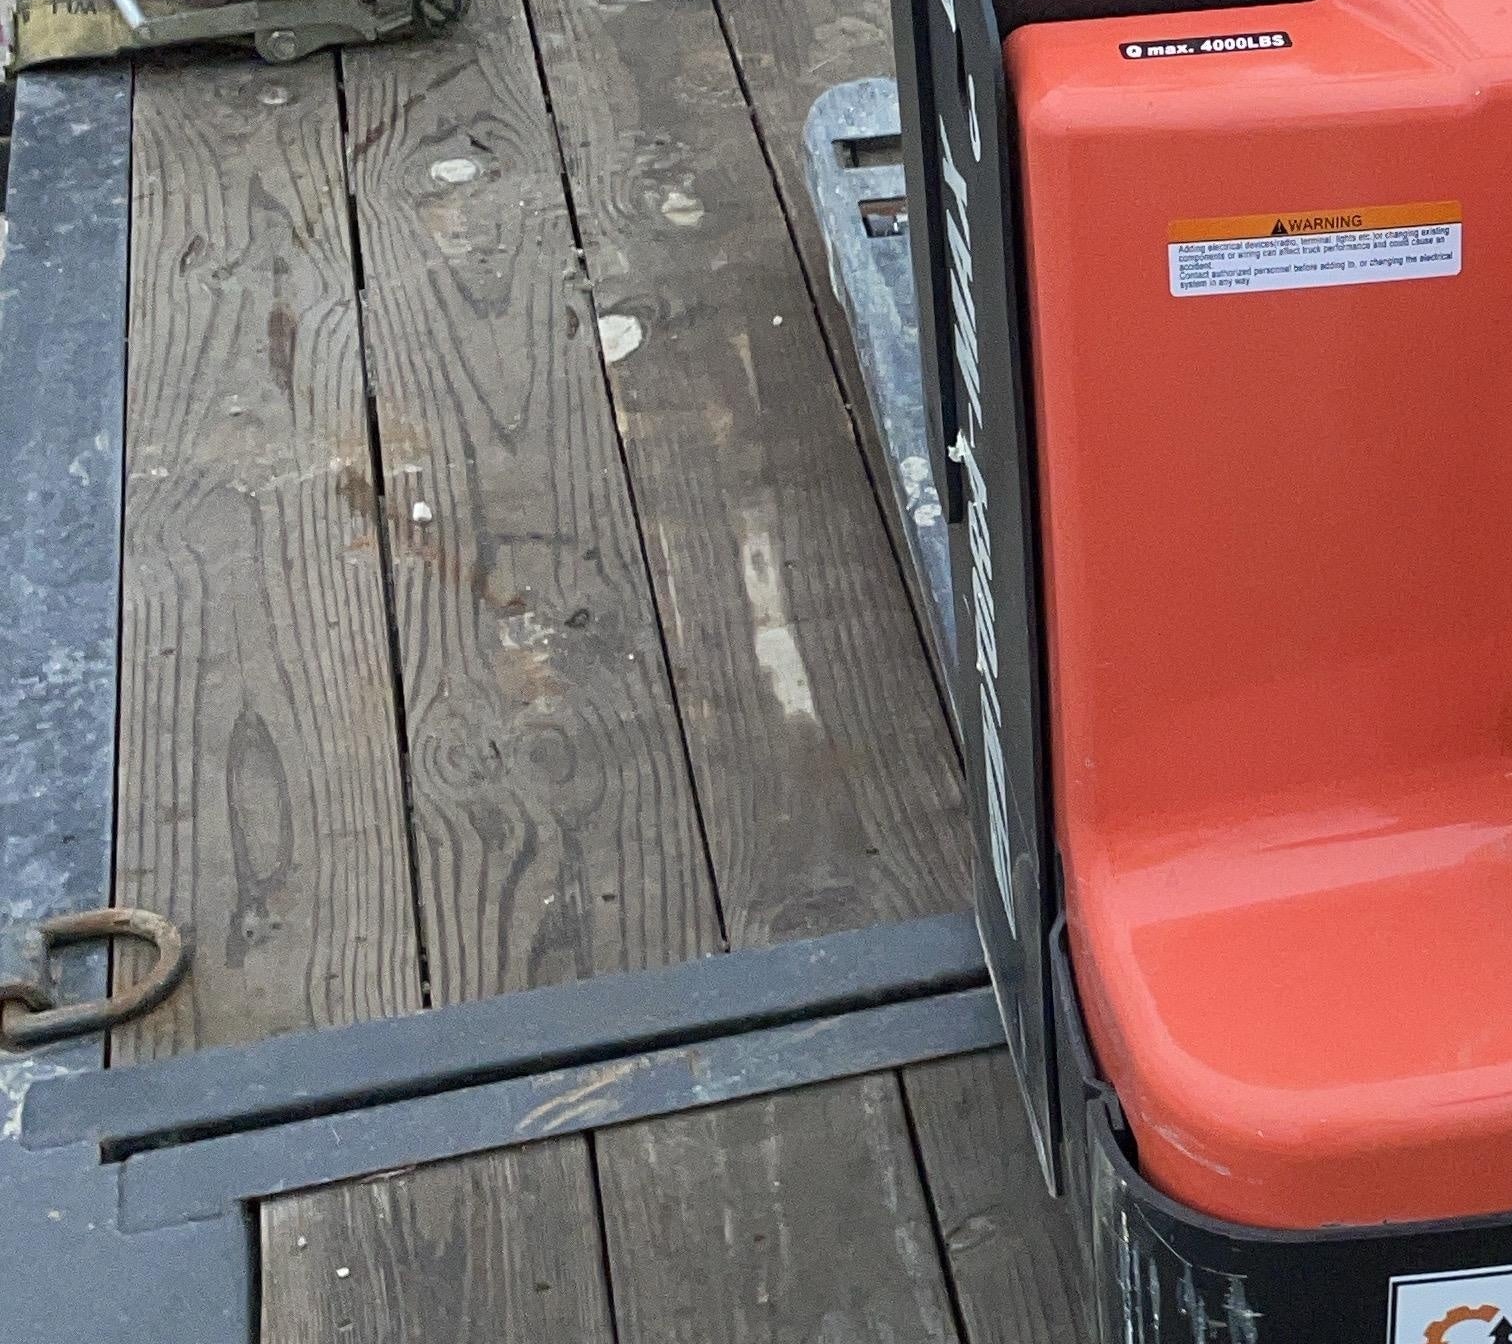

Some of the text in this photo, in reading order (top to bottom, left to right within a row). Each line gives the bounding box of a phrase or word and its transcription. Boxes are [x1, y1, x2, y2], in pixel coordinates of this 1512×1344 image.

[1125, 34, 1286, 58] Q max. 4000LBS
[1289, 215, 1362, 233] WARNING
